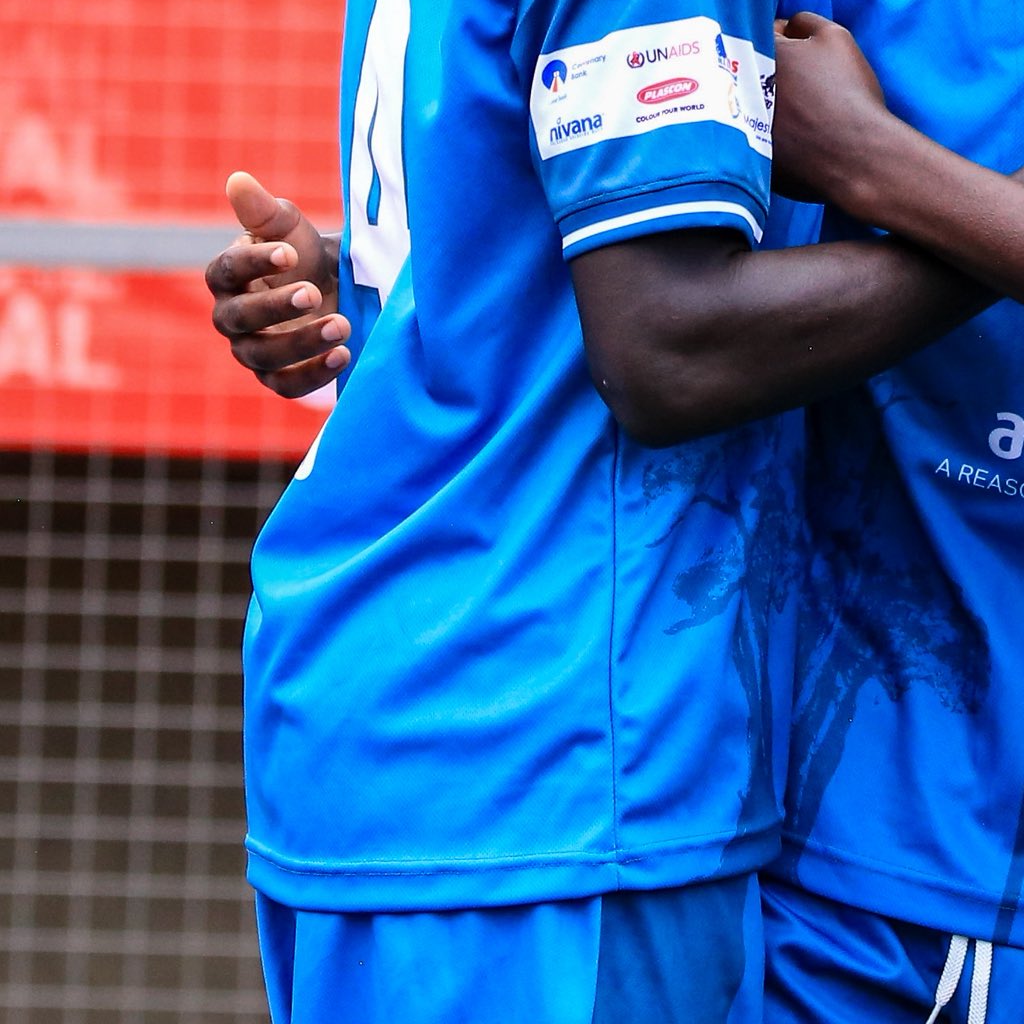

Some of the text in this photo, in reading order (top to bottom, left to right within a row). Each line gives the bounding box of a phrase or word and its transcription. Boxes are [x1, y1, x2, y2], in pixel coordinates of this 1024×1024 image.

[646, 41, 700, 63] UNAIDS
[644, 81, 692, 101] PLASCON
[636, 112, 660, 123] COLOUR
[550, 114, 603, 142] nivana
[935, 458, 950, 478] A
